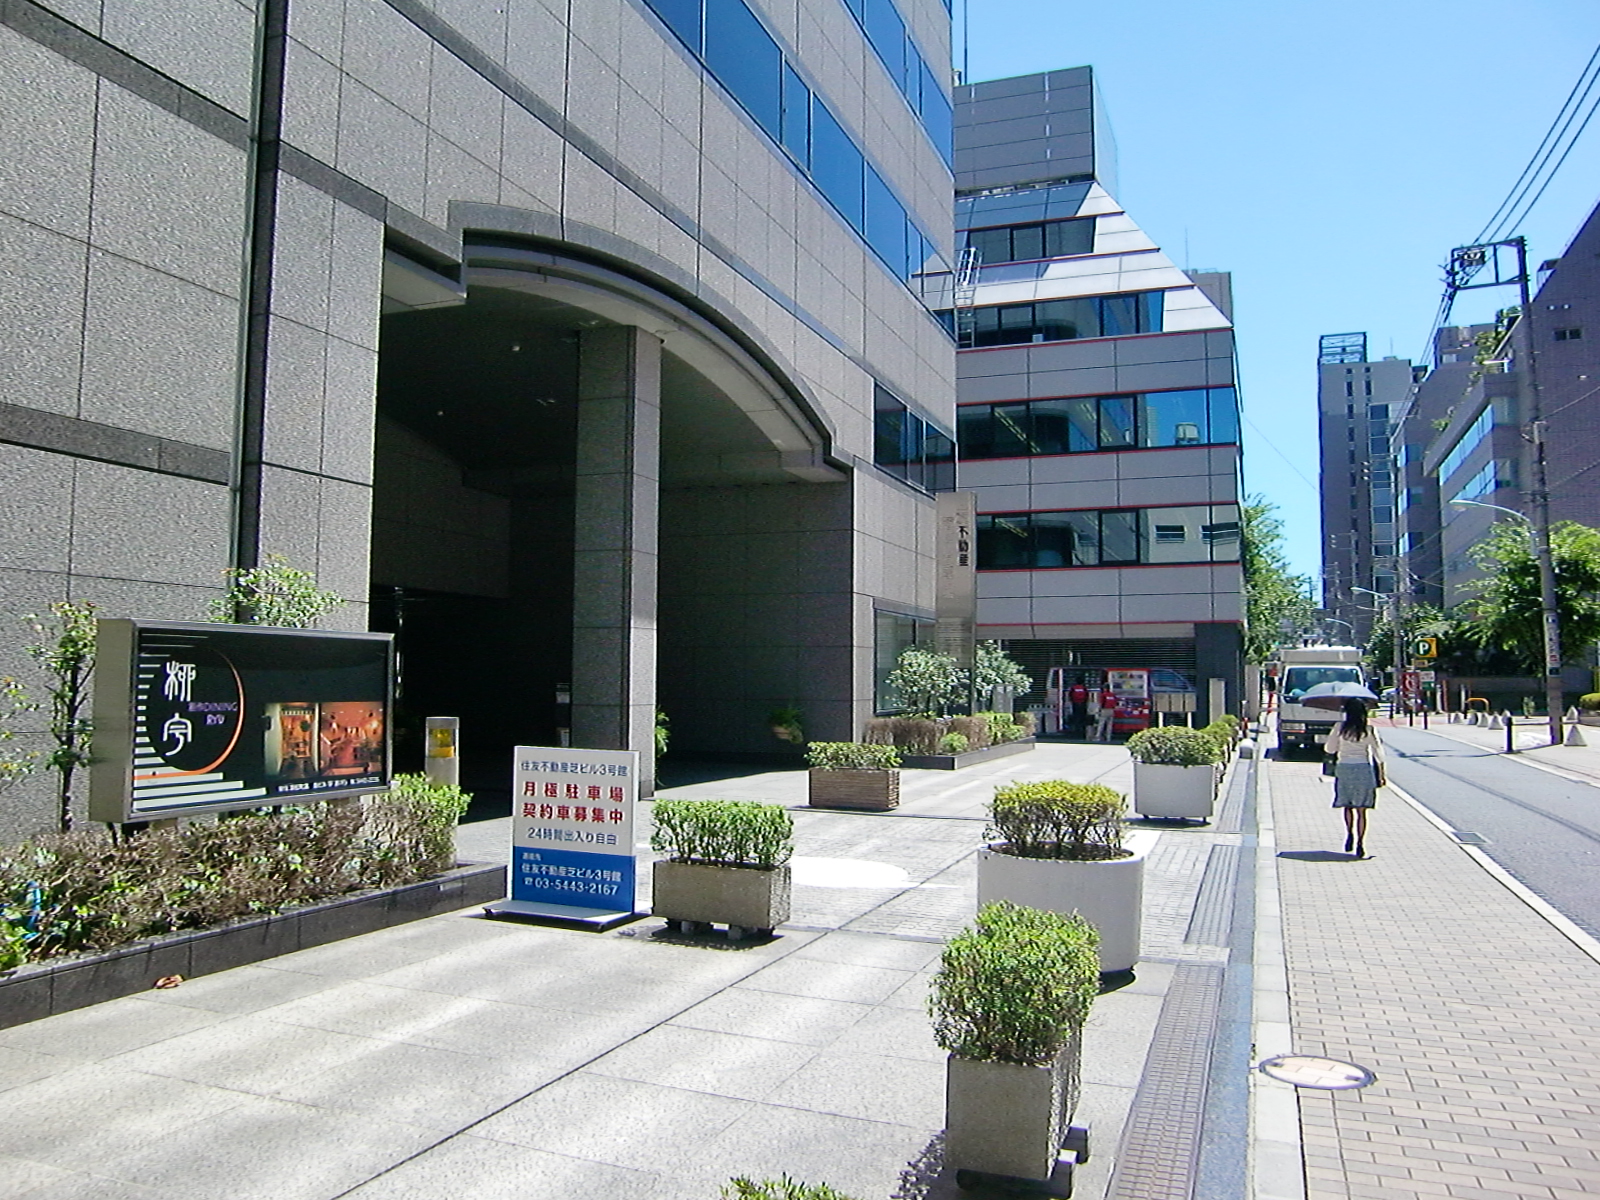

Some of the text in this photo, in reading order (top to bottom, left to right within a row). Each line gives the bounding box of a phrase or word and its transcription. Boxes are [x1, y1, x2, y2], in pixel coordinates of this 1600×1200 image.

[1419, 642, 1429, 655] P
[523, 781, 624, 802] 月極駐車場
[523, 803, 624, 824] 契約車募集中
[535, 877, 618, 896] 03-5443-2167
